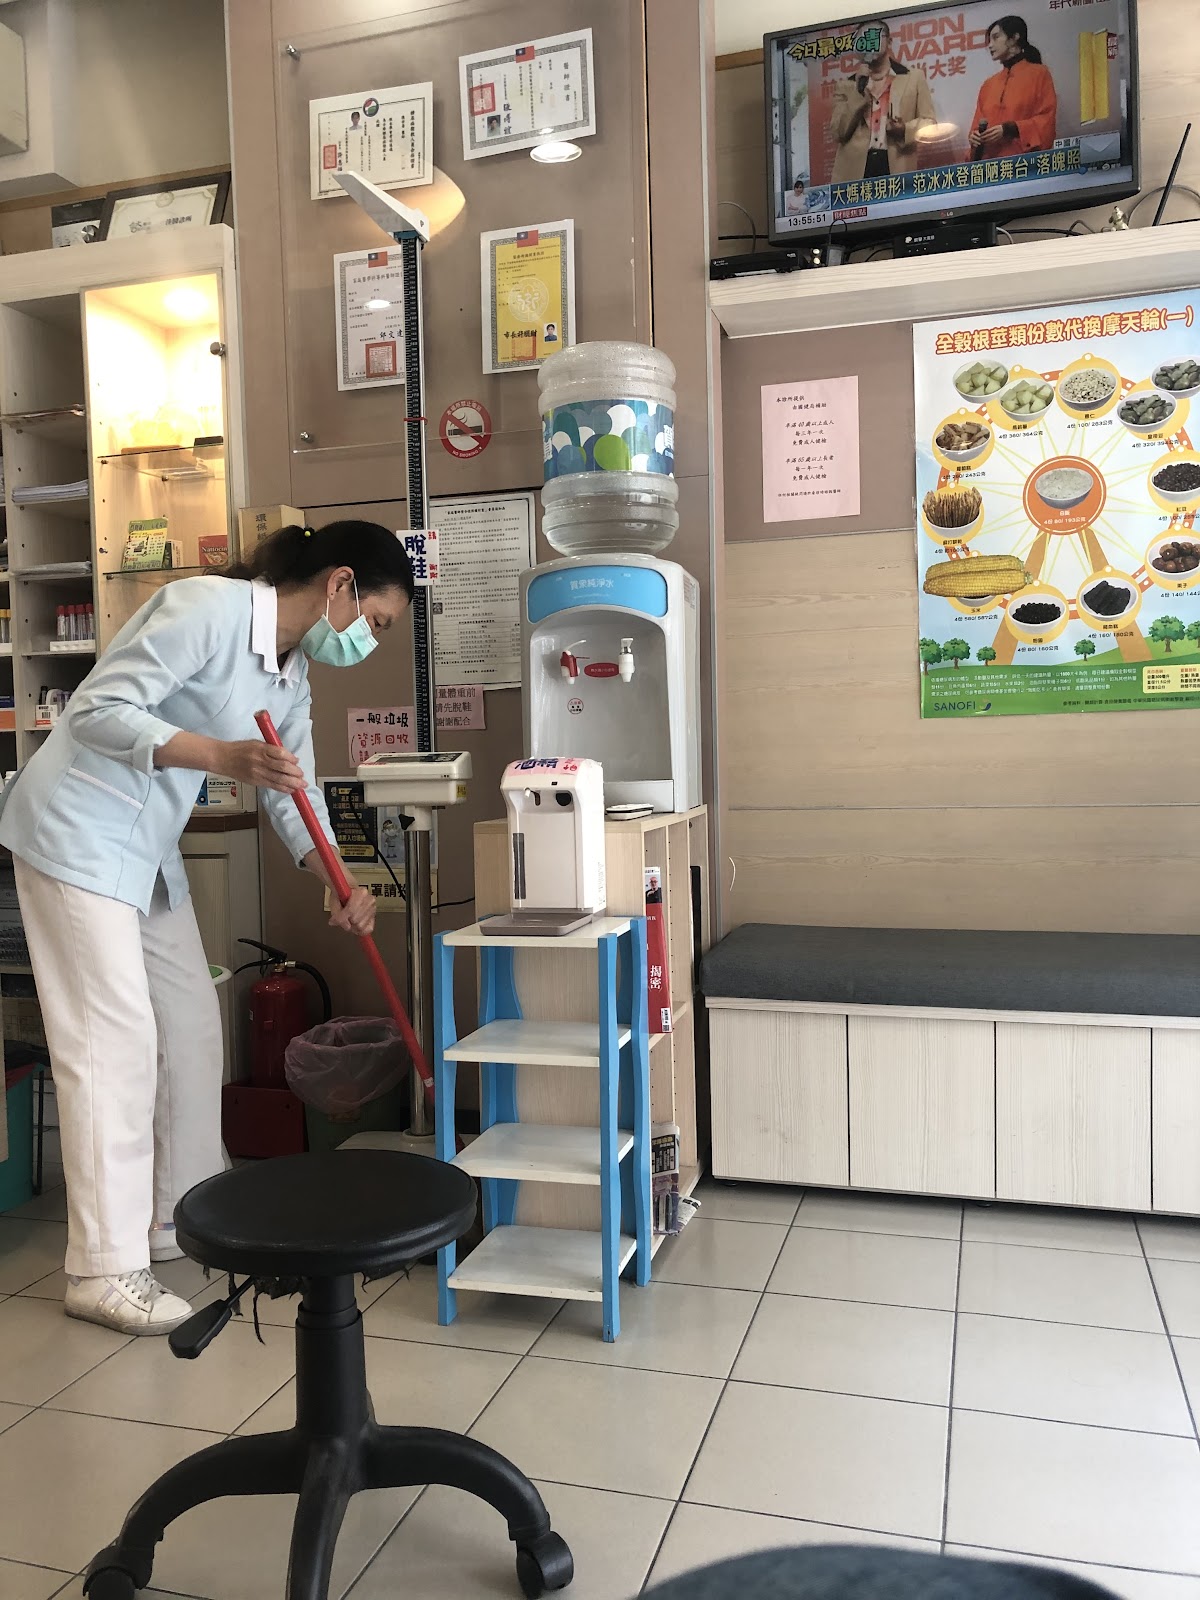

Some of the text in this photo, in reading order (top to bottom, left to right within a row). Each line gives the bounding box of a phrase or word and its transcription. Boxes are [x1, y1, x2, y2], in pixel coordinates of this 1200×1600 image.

[788, 214, 827, 227] 13:55:51
[935, 304, 1194, 355] 全穀根莖類份數代換摩天輪(一)
[404, 533, 428, 579] 脫鞋
[933, 701, 976, 712] SANOFI
[356, 712, 409, 728] 一般垃圾
[650, 964, 662, 990] 揭密
